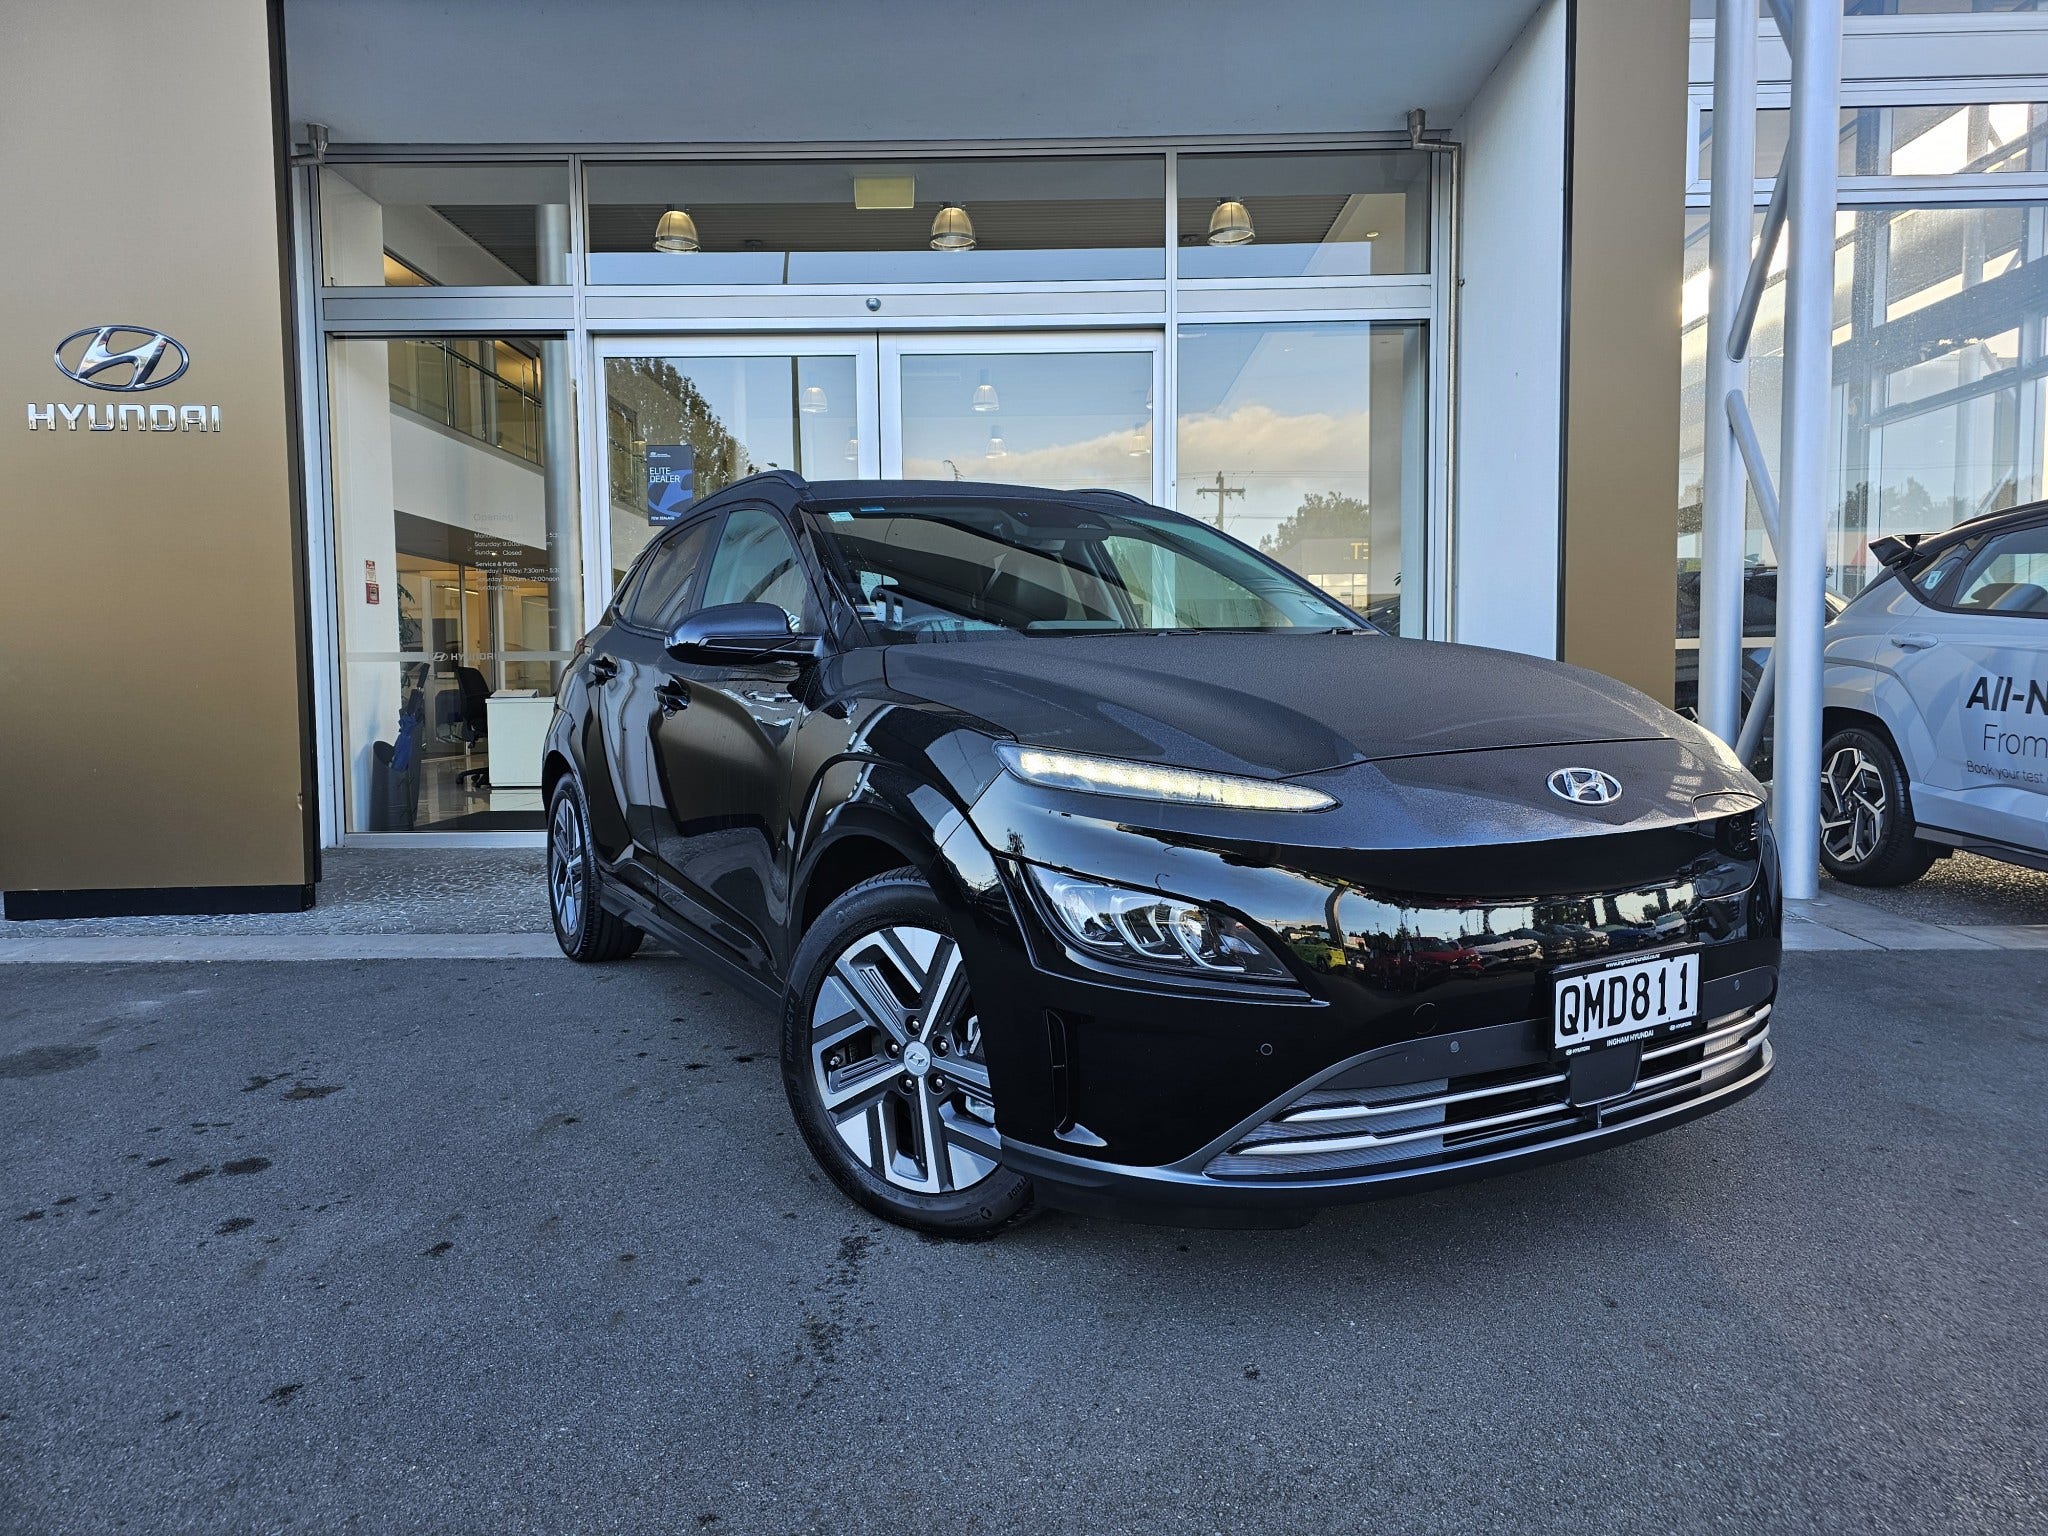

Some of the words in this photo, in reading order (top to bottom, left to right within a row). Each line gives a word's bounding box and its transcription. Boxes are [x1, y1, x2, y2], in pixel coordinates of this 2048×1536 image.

[28, 403, 221, 432] HYUNDAI
[649, 467, 671, 475] ELITE
[649, 475, 681, 483] DEALER
[450, 652, 498, 661] HYDAI
[1983, 723, 2048, 759] From
[1966, 760, 1994, 776] Book
[1994, 767, 2020, 780] your
[2022, 770, 2045, 784] test
[1559, 962, 1688, 1037] QMD811
[1606, 1033, 1630, 1048] INGHAM
[1629, 1029, 1654, 1042] HYUNDAI
